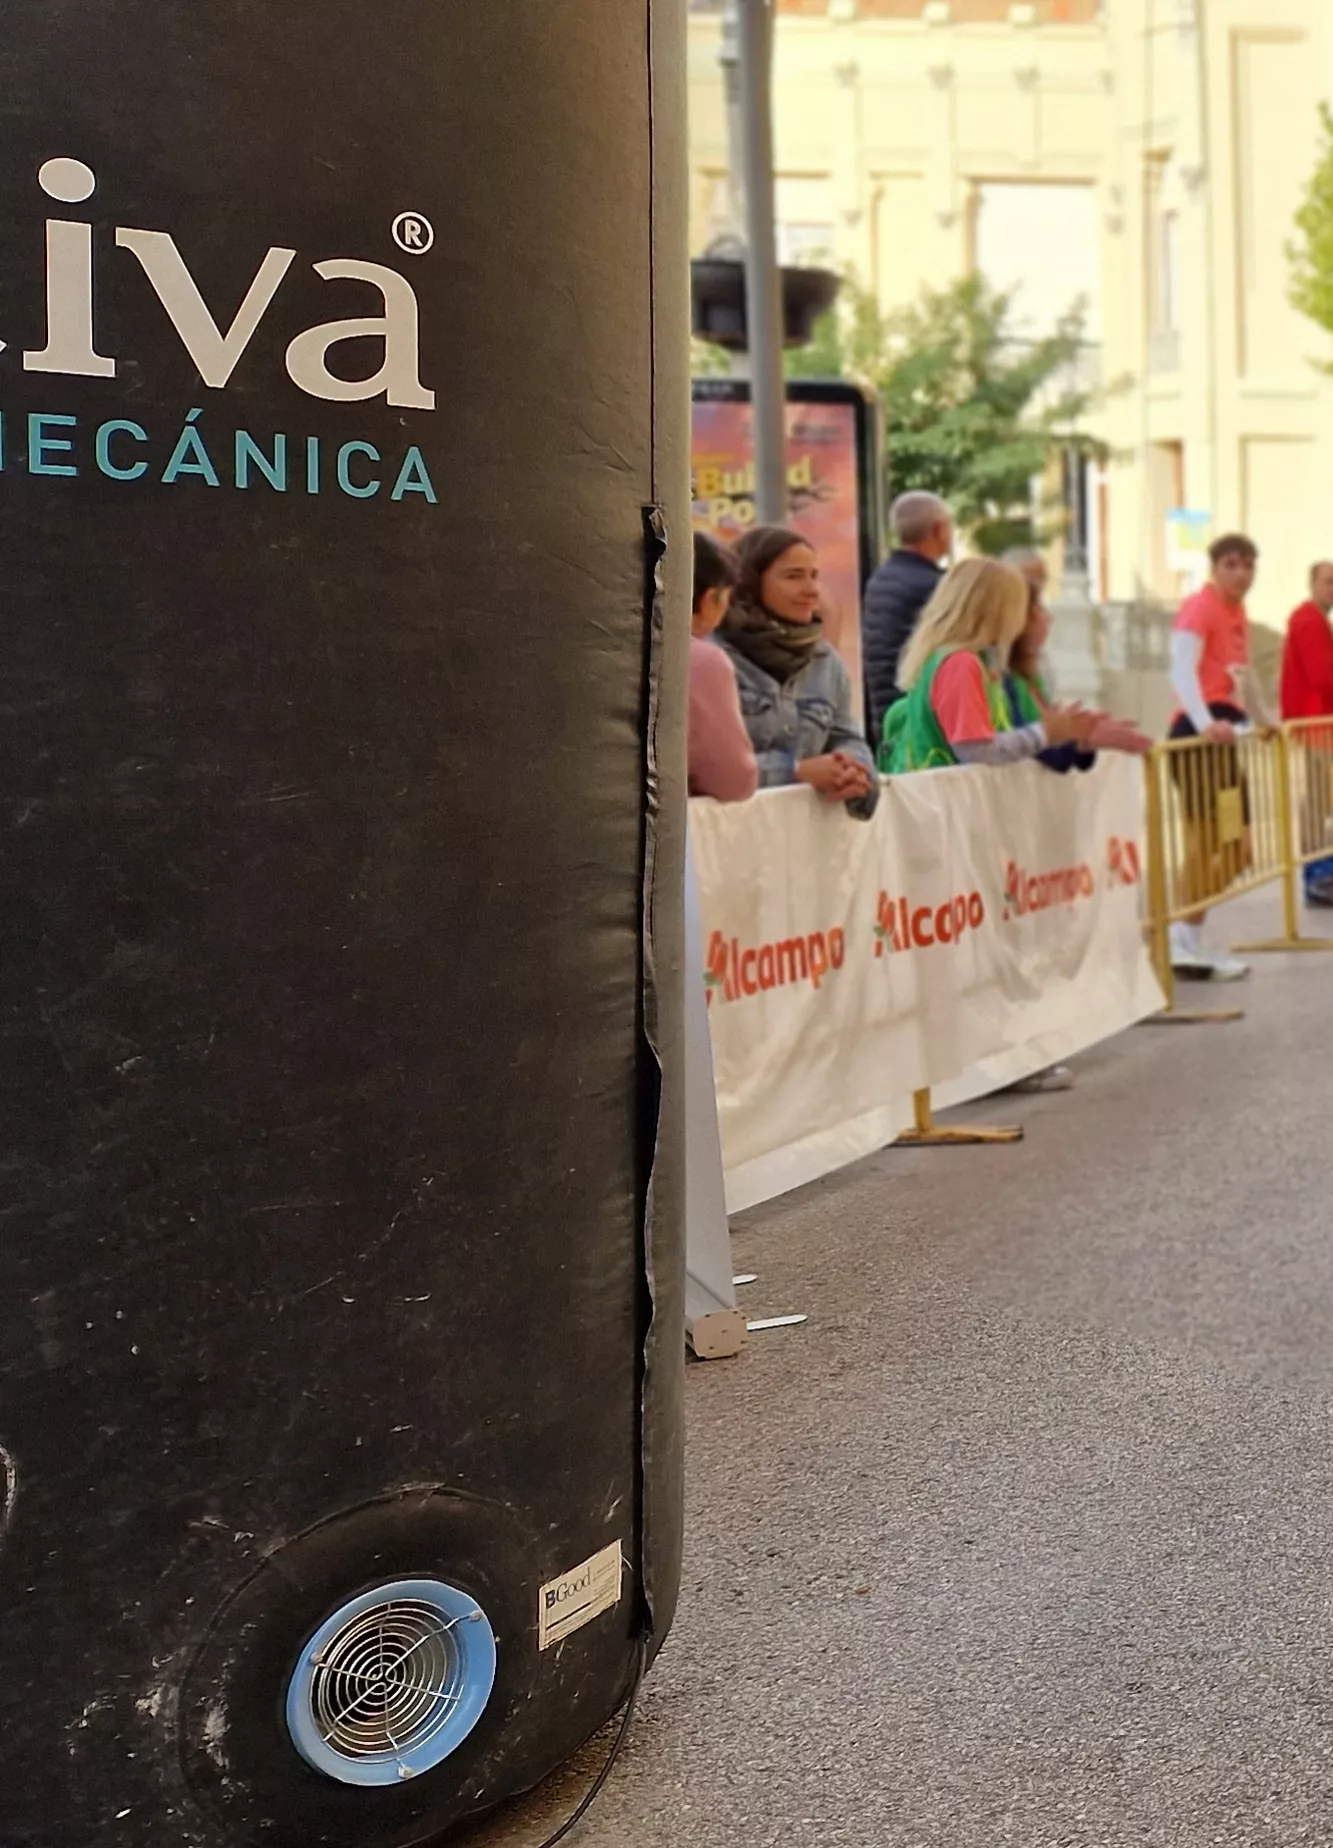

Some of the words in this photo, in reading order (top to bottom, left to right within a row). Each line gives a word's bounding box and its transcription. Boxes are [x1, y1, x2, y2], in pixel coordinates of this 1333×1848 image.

[0, 408, 438, 504] ECÁNICA
[704, 927, 845, 1008] Alcampo
[1003, 860, 1095, 921] Alcampo
[545, 1566, 591, 1609] BGood
